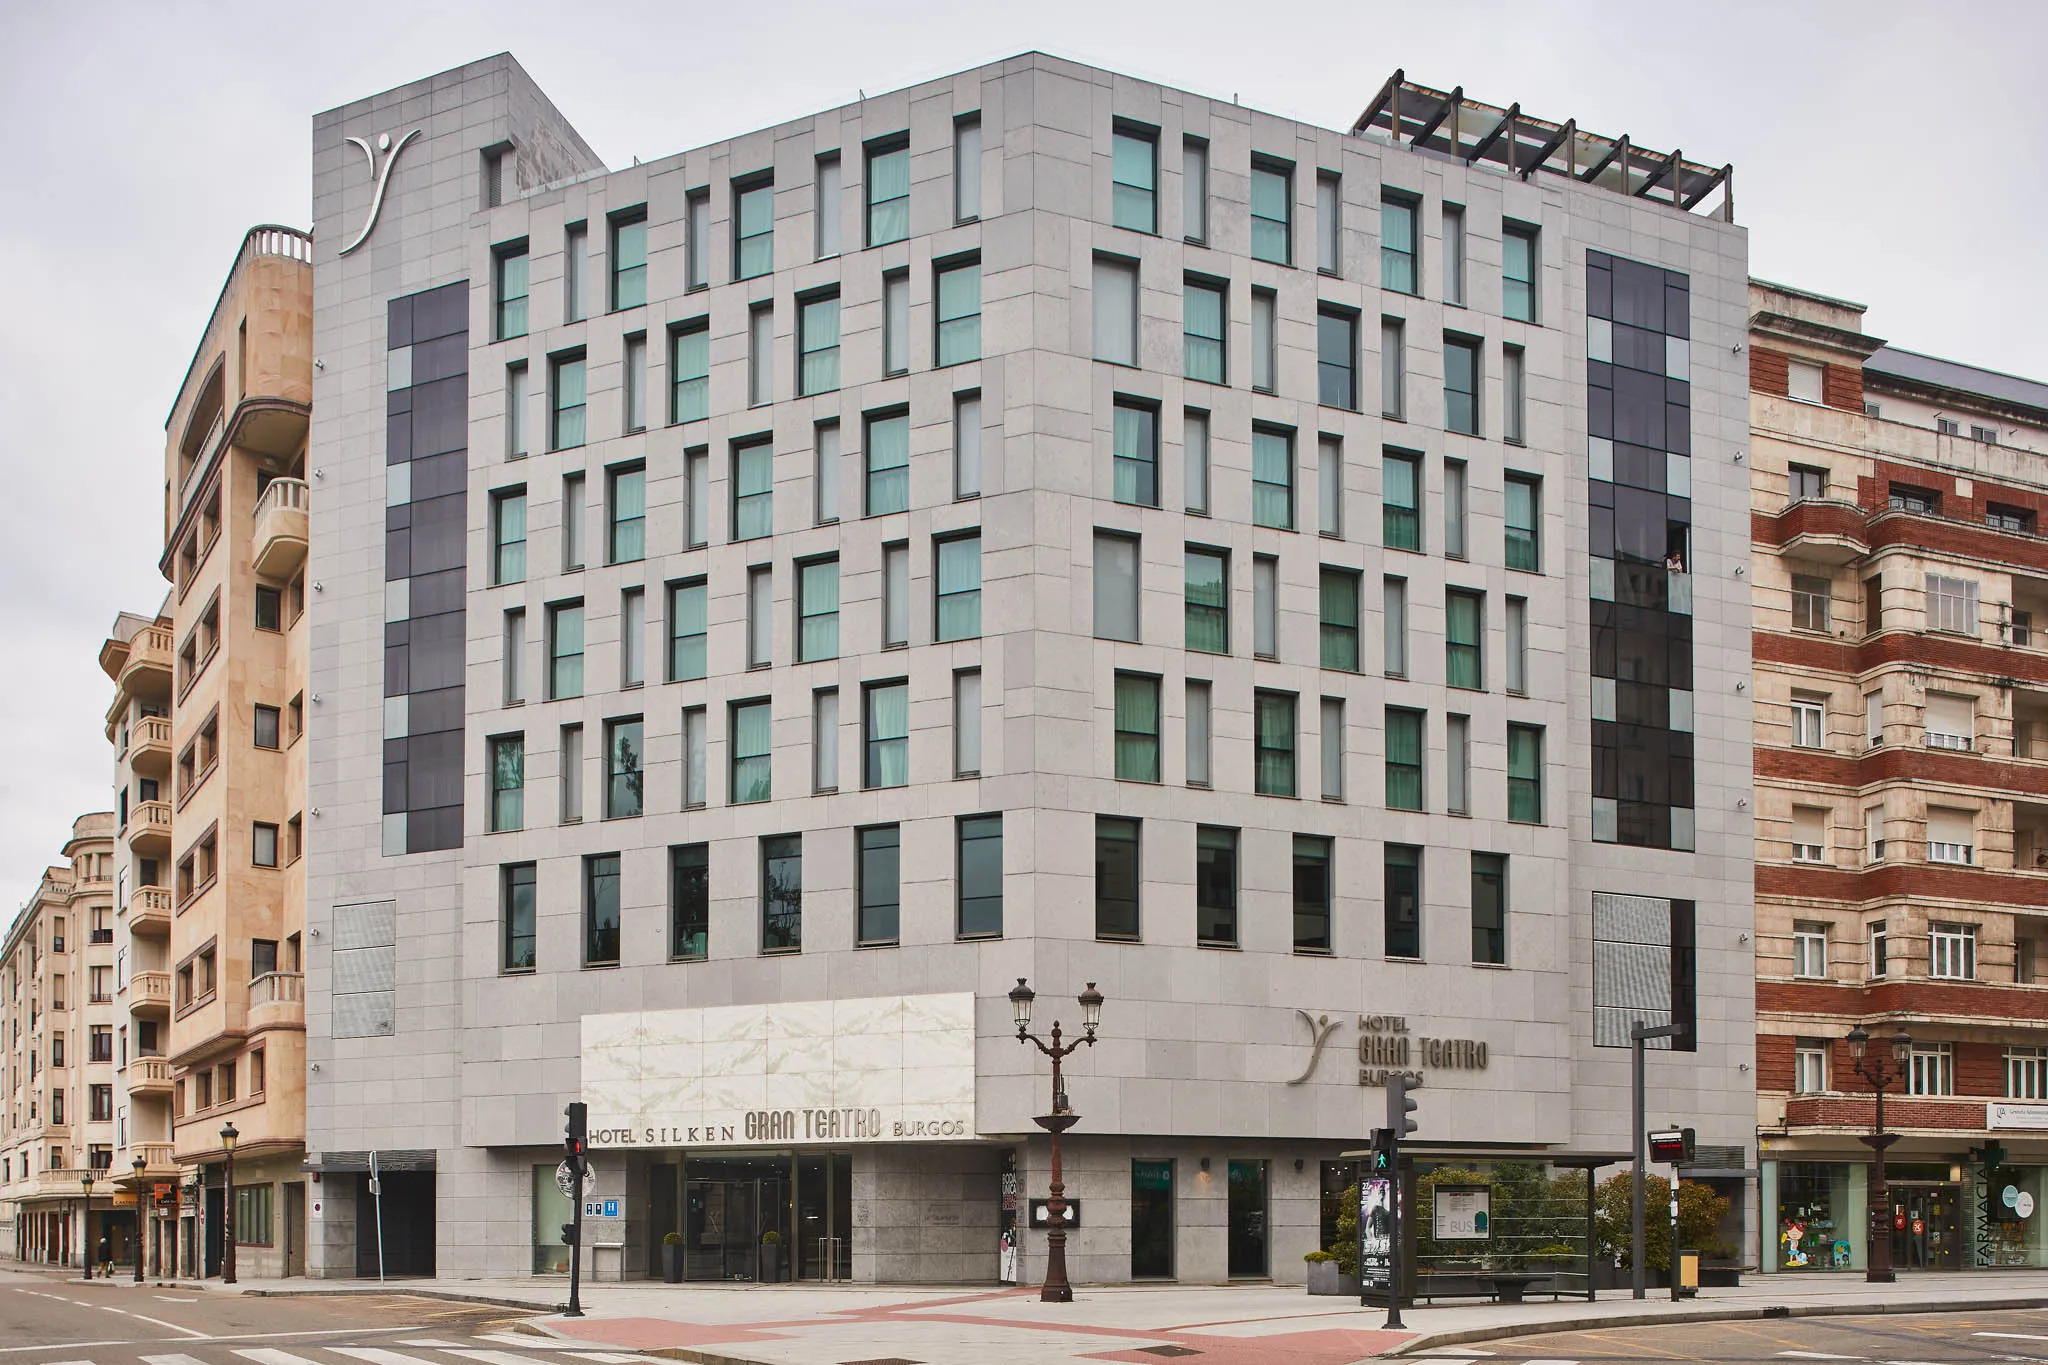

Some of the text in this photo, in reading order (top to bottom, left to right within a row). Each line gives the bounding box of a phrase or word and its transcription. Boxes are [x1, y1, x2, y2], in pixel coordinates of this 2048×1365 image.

[1358, 1015, 1410, 1033] HOTEL
[1358, 1034, 1489, 1070] GRAN TEATRO
[1359, 1069, 1424, 1086] BURS
[589, 1108, 965, 1144] HOTEL SILKEN GRAN TEATRO BURGOS
[608, 1203, 614, 1211] H
[1450, 1220, 1473, 1232] BUS
[1976, 1167, 1989, 1267] FARMACIA
